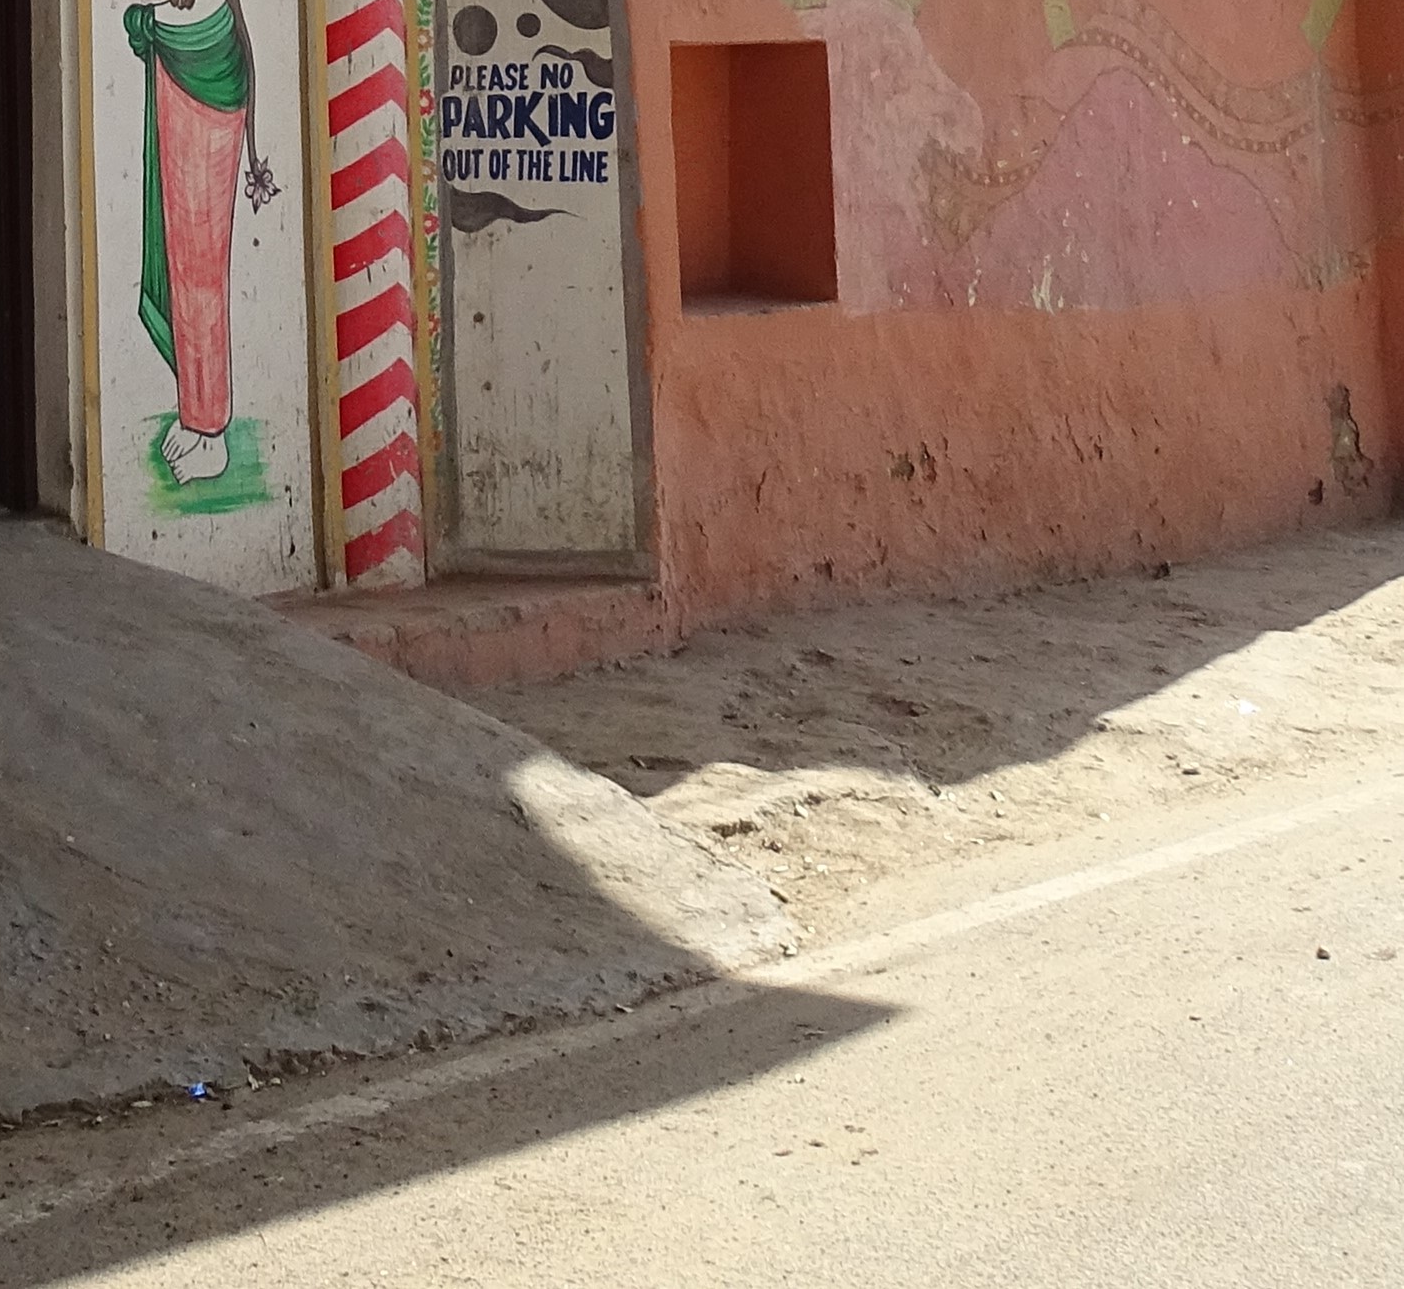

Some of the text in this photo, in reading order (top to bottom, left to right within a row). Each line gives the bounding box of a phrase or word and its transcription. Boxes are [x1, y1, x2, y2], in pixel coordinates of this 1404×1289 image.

[449, 62, 574, 92] PLEASE NO
[442, 90, 616, 148] PARKING
[442, 148, 609, 184] OUT OF THE LINE
